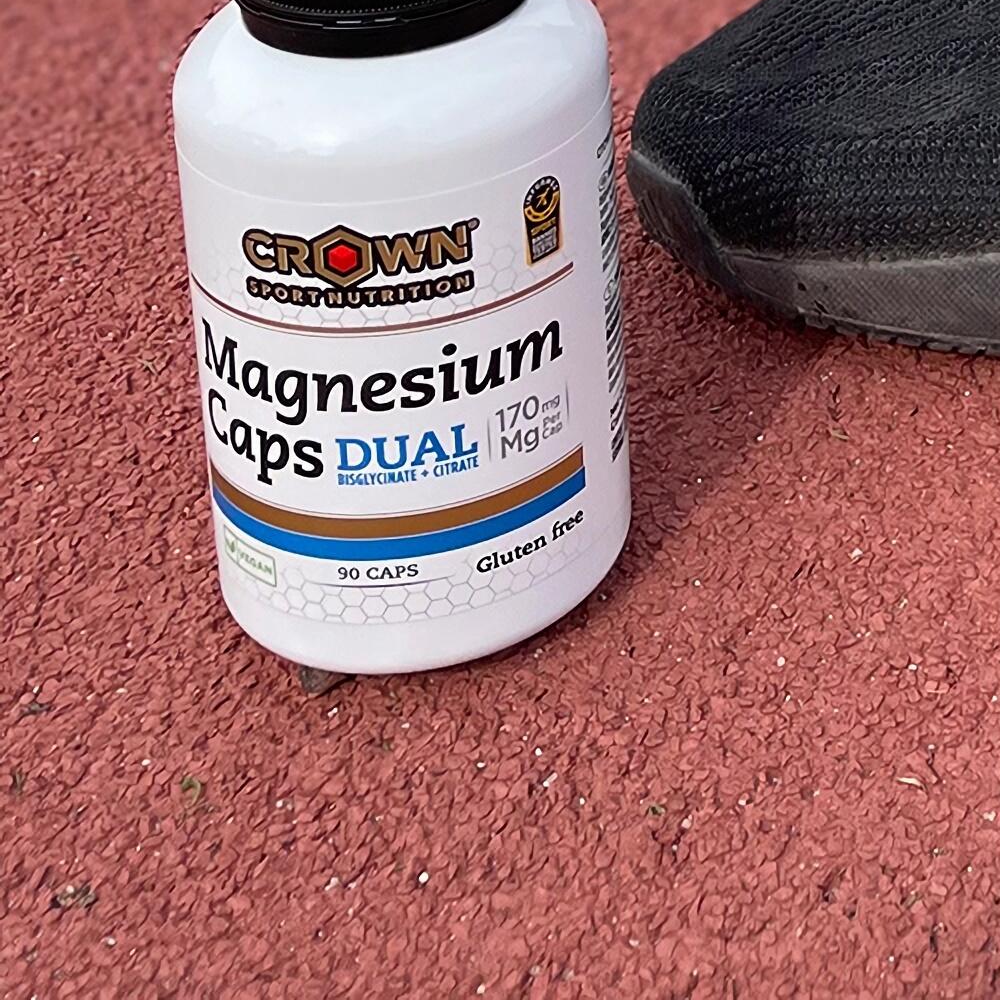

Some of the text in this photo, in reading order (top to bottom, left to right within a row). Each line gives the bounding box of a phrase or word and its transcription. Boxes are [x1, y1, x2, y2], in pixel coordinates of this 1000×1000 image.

[246, 270, 474, 308] SPORT NUTRITION
[201, 318, 563, 425] Magnesium
[495, 394, 561, 433] 170 mg
[207, 388, 324, 485] Caps
[335, 423, 479, 471] DUAL
[501, 426, 540, 459] Mg
[337, 469, 417, 486] BISGLYCINATE
[433, 454, 480, 478] CITRATE
[476, 509, 585, 574] Gluten free
[338, 563, 420, 581] 90 CAPS
